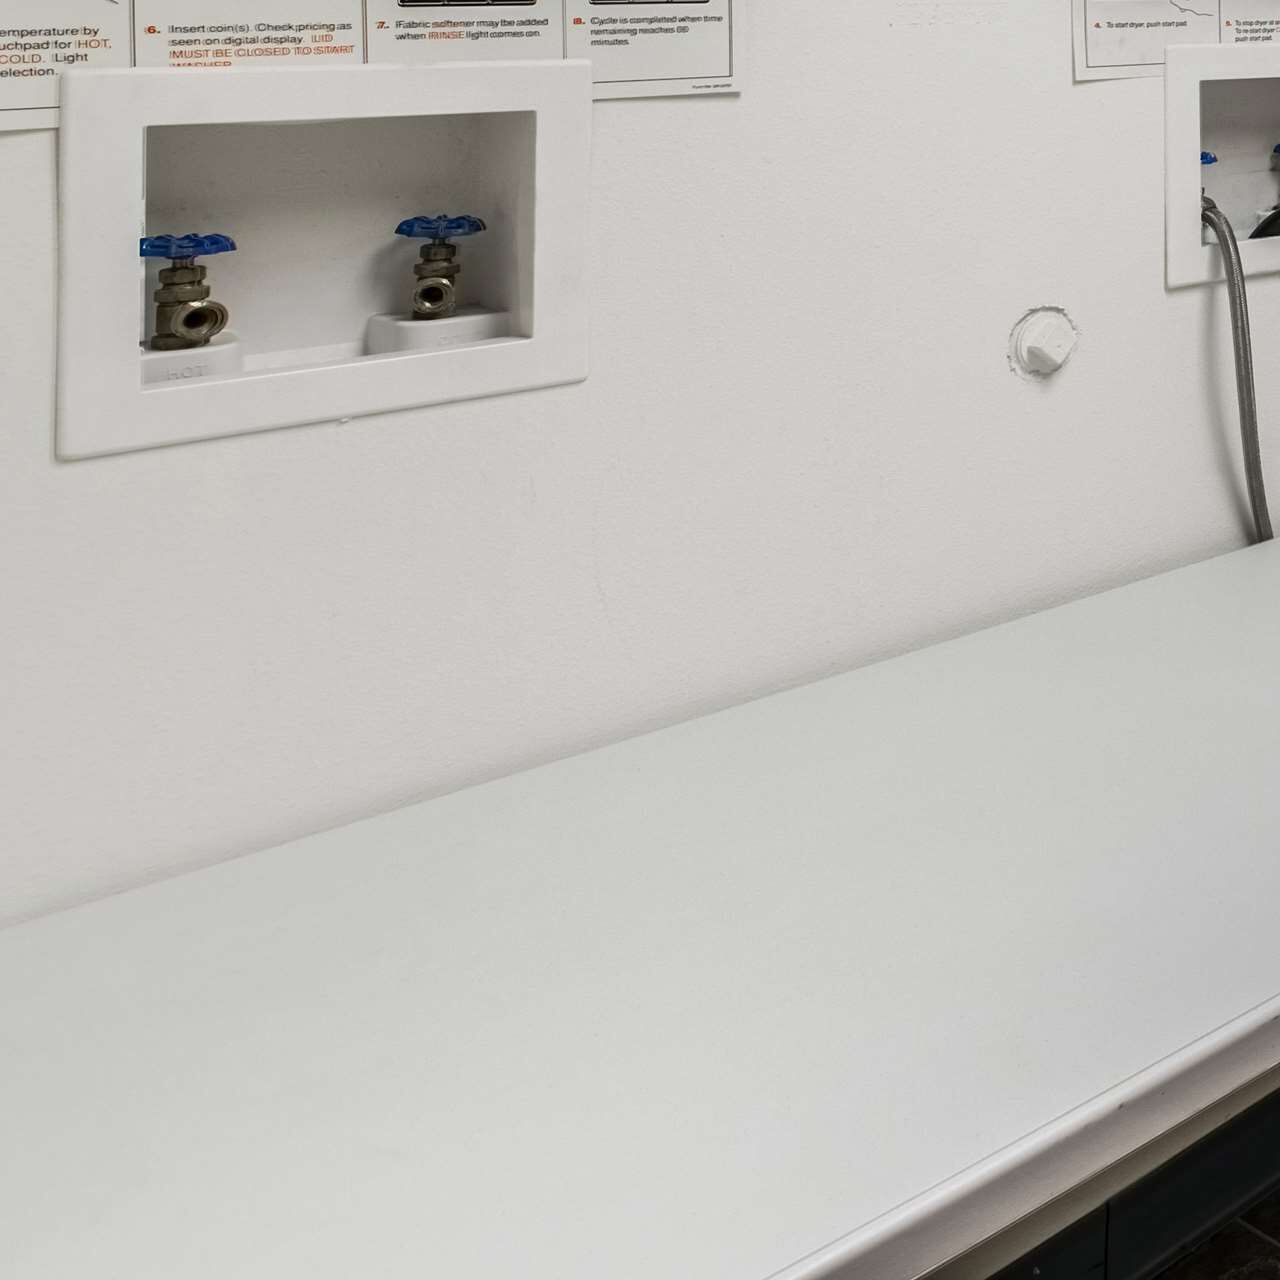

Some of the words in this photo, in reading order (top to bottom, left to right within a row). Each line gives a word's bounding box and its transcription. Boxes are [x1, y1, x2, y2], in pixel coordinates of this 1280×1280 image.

[83, 25, 100, 38] by
[144, 25, 161, 35] 6.
[168, 24, 206, 35] Insert
[255, 22, 294, 33] Check
[295, 21, 336, 34] pricing
[337, 22, 353, 31] as
[53, 39, 73, 50] for
[76, 38, 112, 50] HOT,
[168, 37, 201, 47] seen
[202, 37, 220, 46] on
[221, 35, 260, 47] digital
[169, 48, 210, 60] MUST
[212, 48, 233, 58] BE
[234, 46, 291, 58] CLOSED
[294, 45, 313, 56] TO
[54, 53, 89, 65] Light
